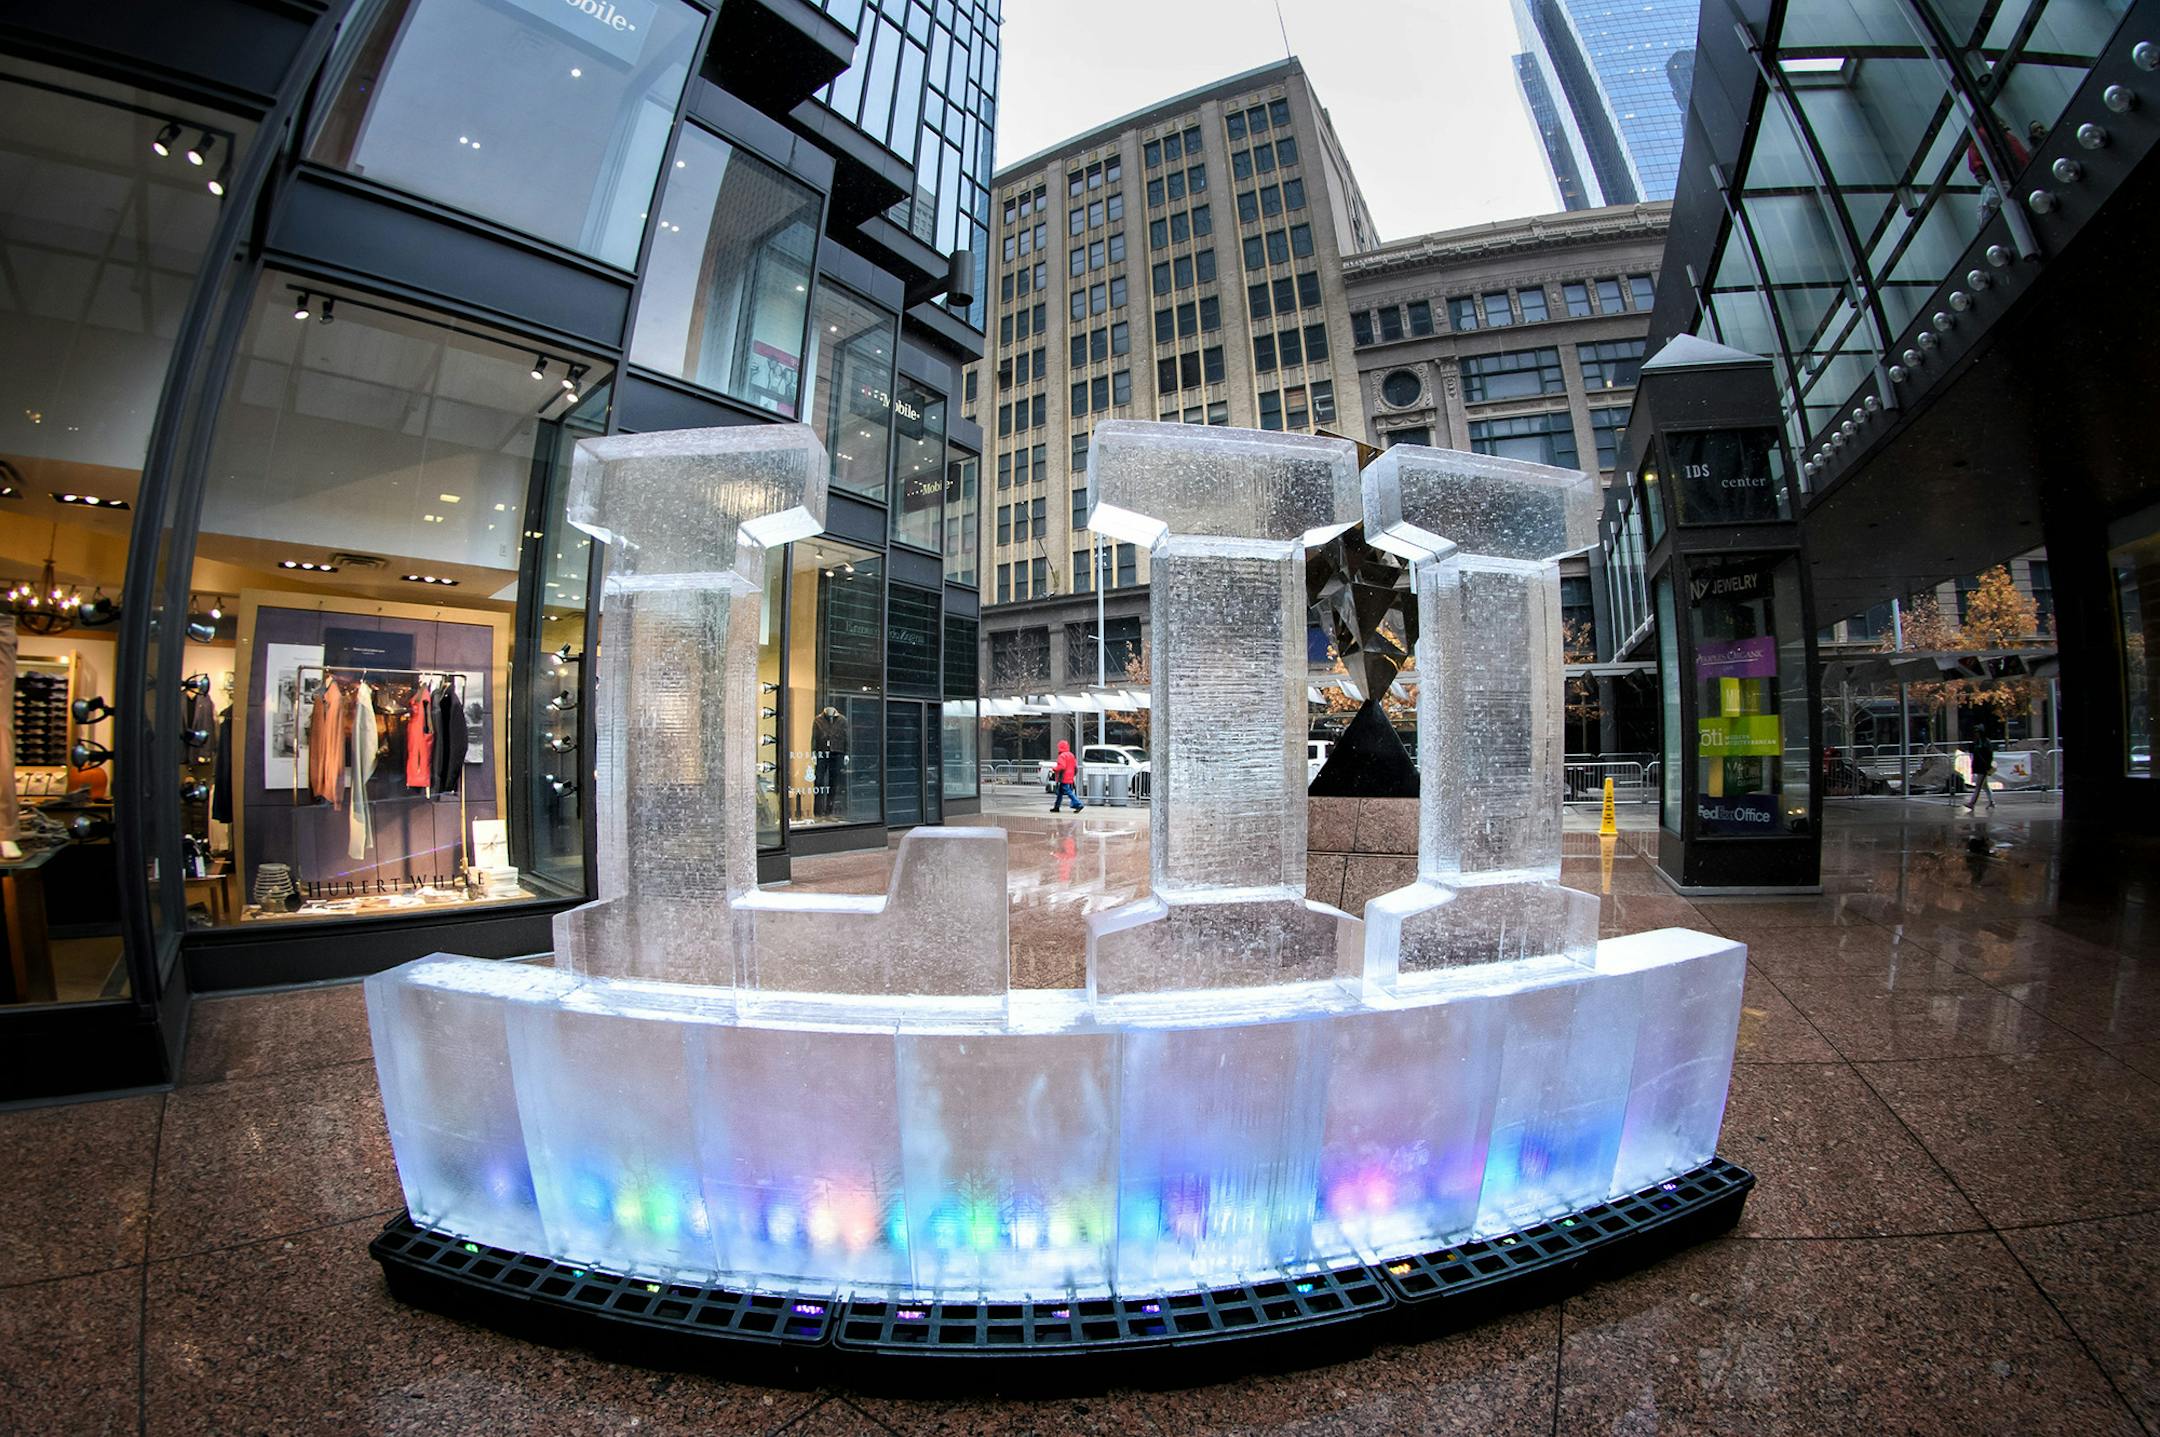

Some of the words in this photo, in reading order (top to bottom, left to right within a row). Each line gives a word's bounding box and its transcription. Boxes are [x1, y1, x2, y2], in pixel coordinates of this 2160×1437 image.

[1686, 464, 1710, 478] IDS
[1721, 476, 1766, 488] center
[1712, 573, 1757, 594] JEWELRY
[1734, 807, 1770, 822] Office
[308, 879, 400, 898] HUBERT
[410, 872, 485, 890] WHITE
